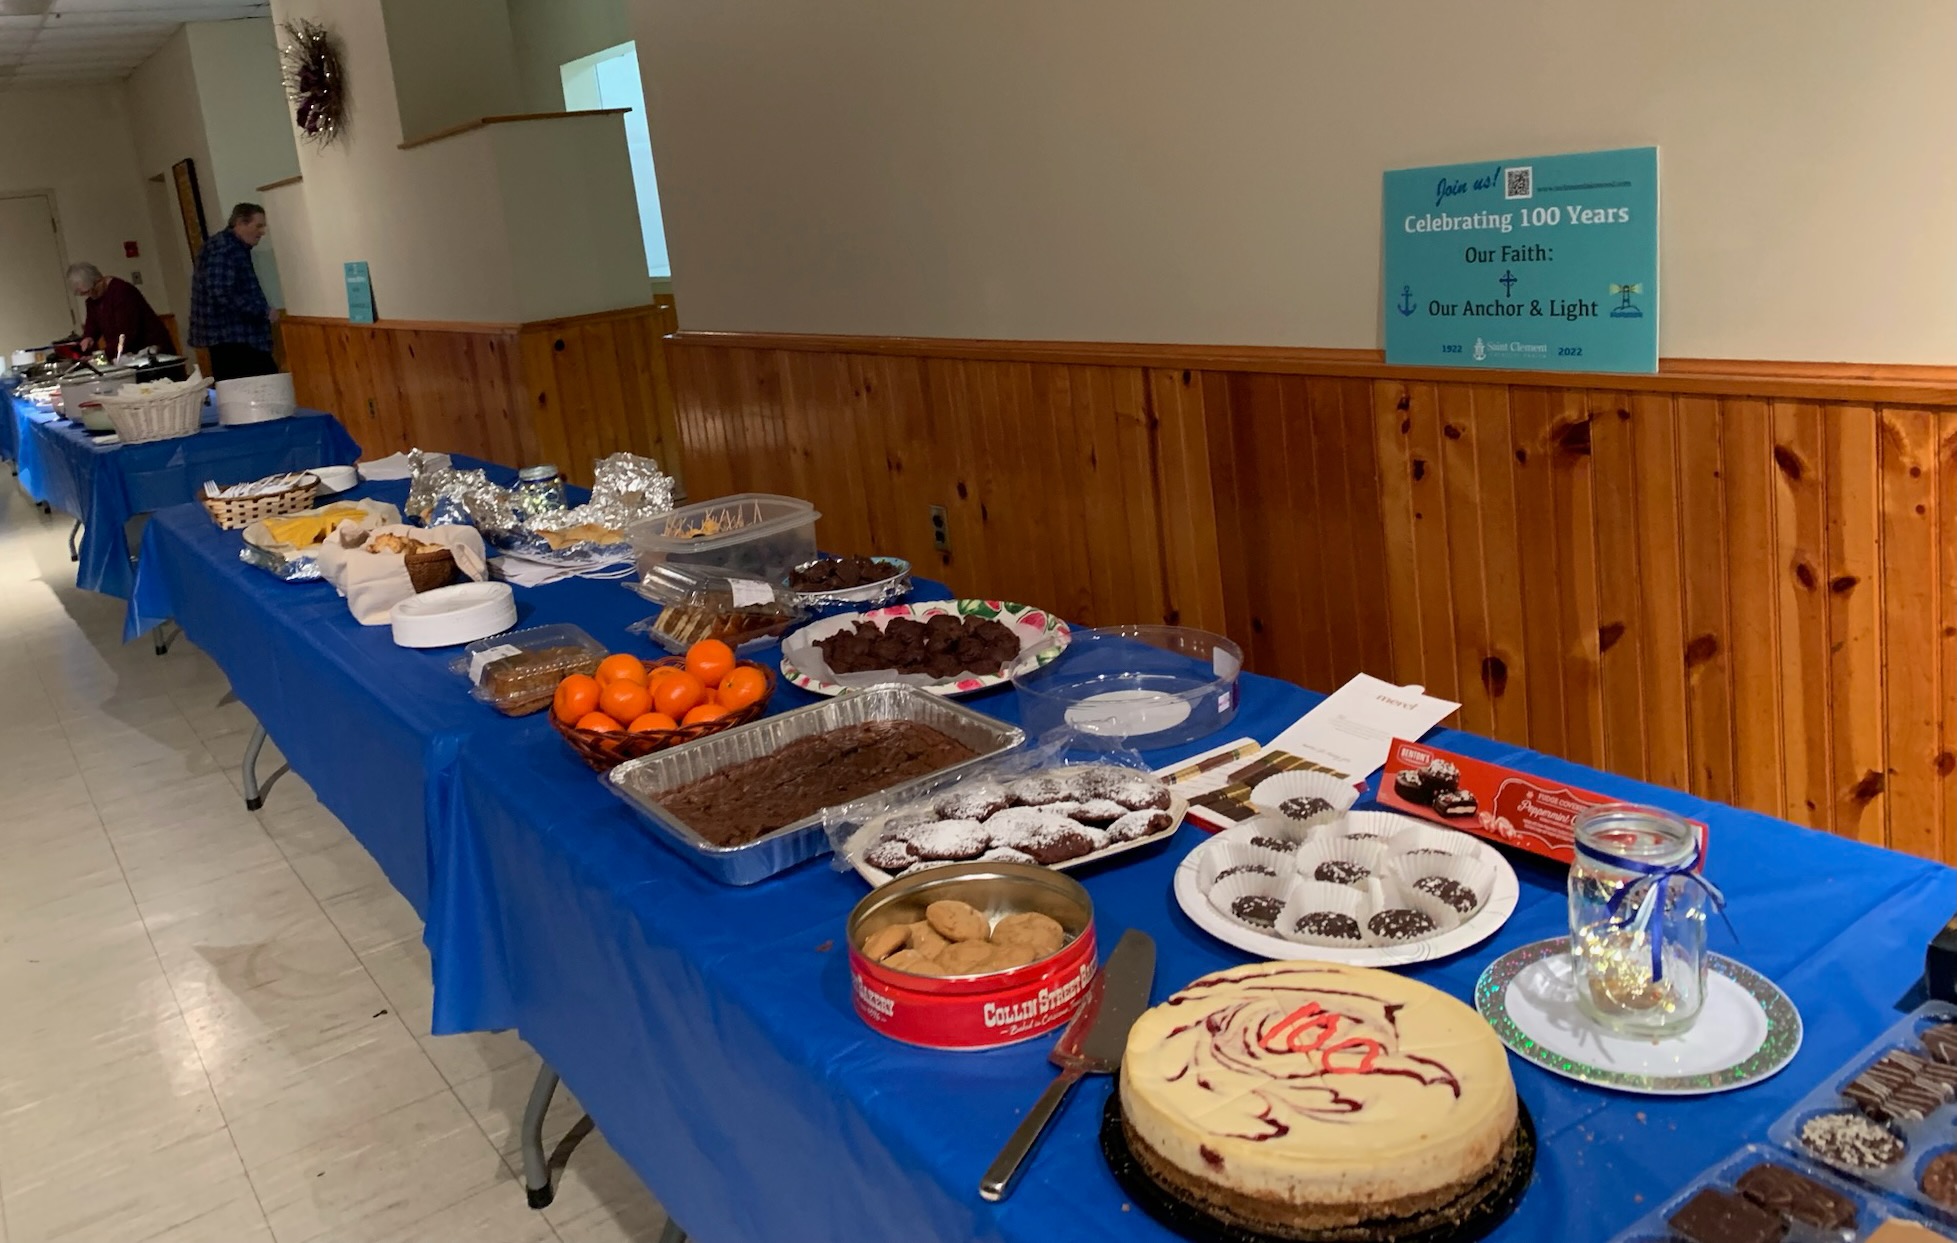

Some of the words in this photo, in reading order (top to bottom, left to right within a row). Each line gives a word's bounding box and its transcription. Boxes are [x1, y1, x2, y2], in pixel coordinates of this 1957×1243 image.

[1436, 178, 1468, 207] Join
[1473, 166, 1501, 191] us!
[1404, 209, 1513, 233] Celebrating
[1520, 206, 1560, 227] 100
[1566, 205, 1630, 225] Years
[1465, 246, 1496, 263] Our
[1501, 244, 1553, 262] Faith:
[1429, 300, 1458, 316] Our
[1462, 299, 1525, 316] Anchor
[1530, 300, 1543, 316] &
[1549, 299, 1599, 321] Light
[1442, 344, 1463, 353] 1922
[1558, 347, 1583, 356] 2022
[1517, 799, 1570, 824] Peppermint
[984, 998, 1038, 1028] COLLIN
[1038, 975, 1080, 1015] STREET
